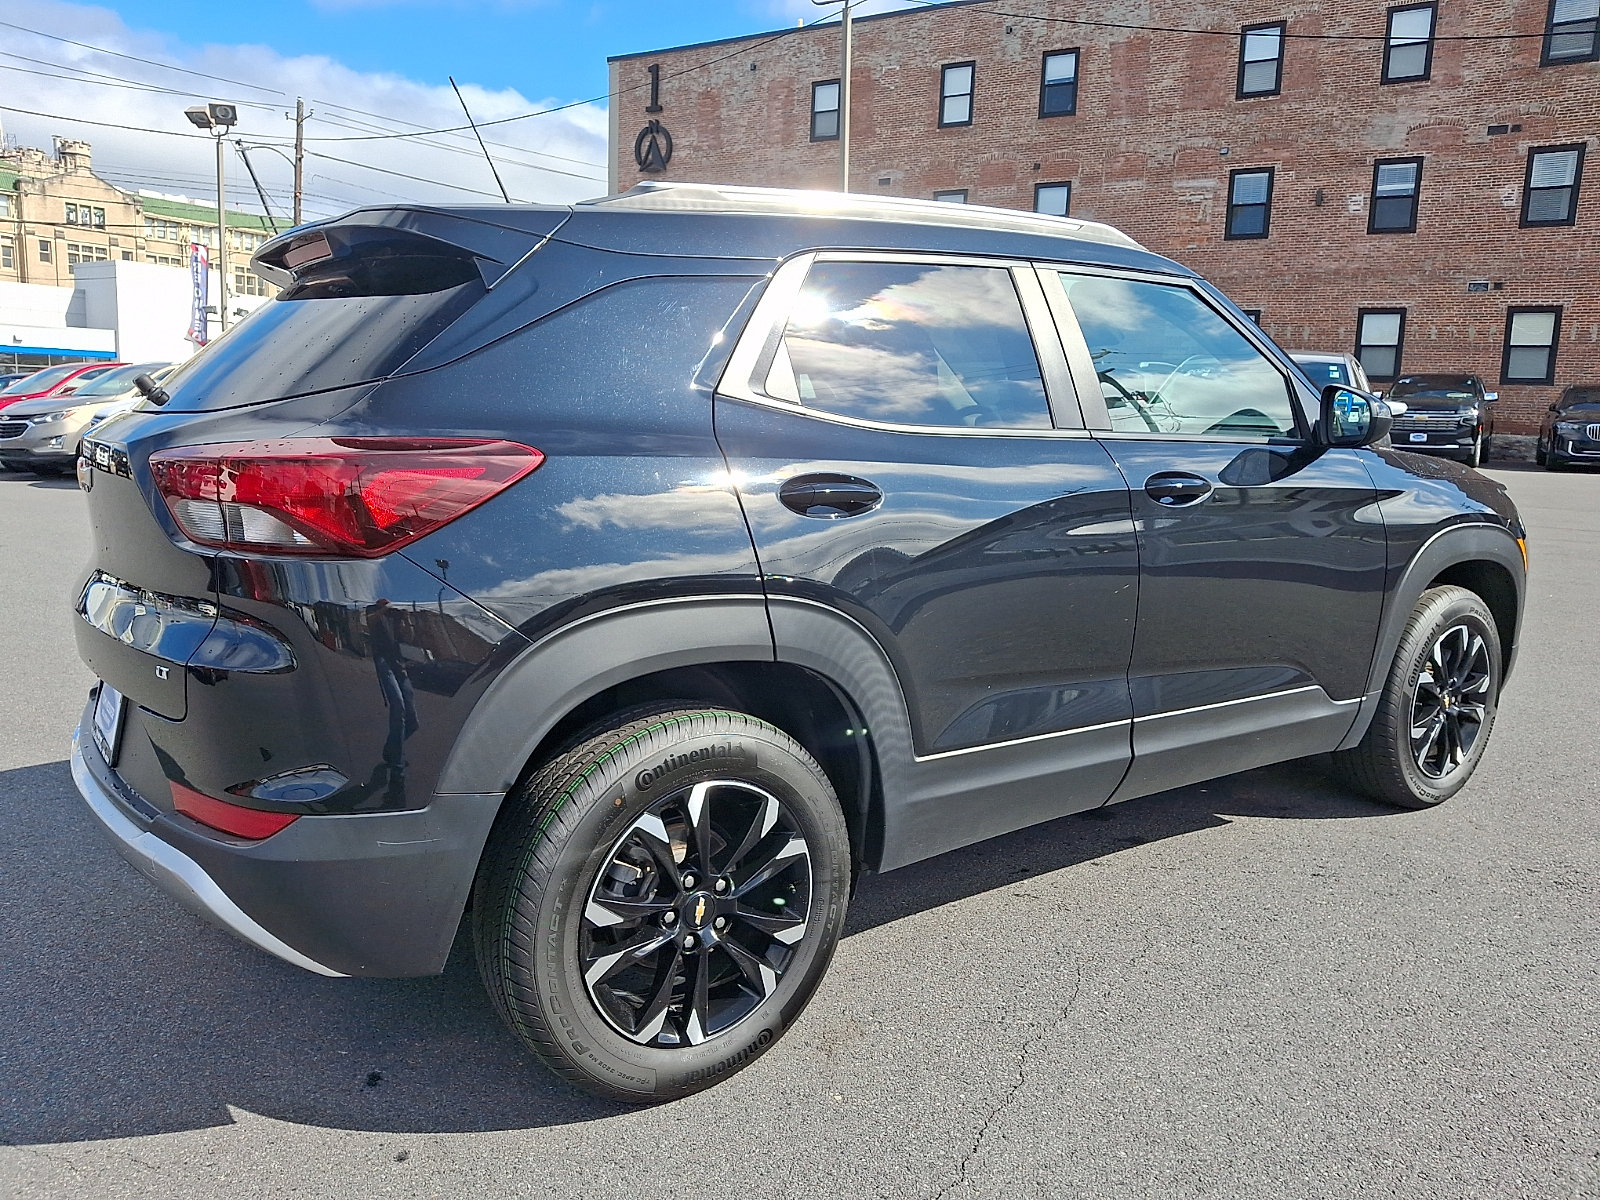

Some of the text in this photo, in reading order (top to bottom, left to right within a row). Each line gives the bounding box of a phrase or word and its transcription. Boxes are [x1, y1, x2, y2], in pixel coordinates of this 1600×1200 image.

[645, 63, 663, 113] 1
[155, 665, 171, 680] LT
[1407, 627, 1437, 688] Continental
[634, 741, 732, 792] Continental
